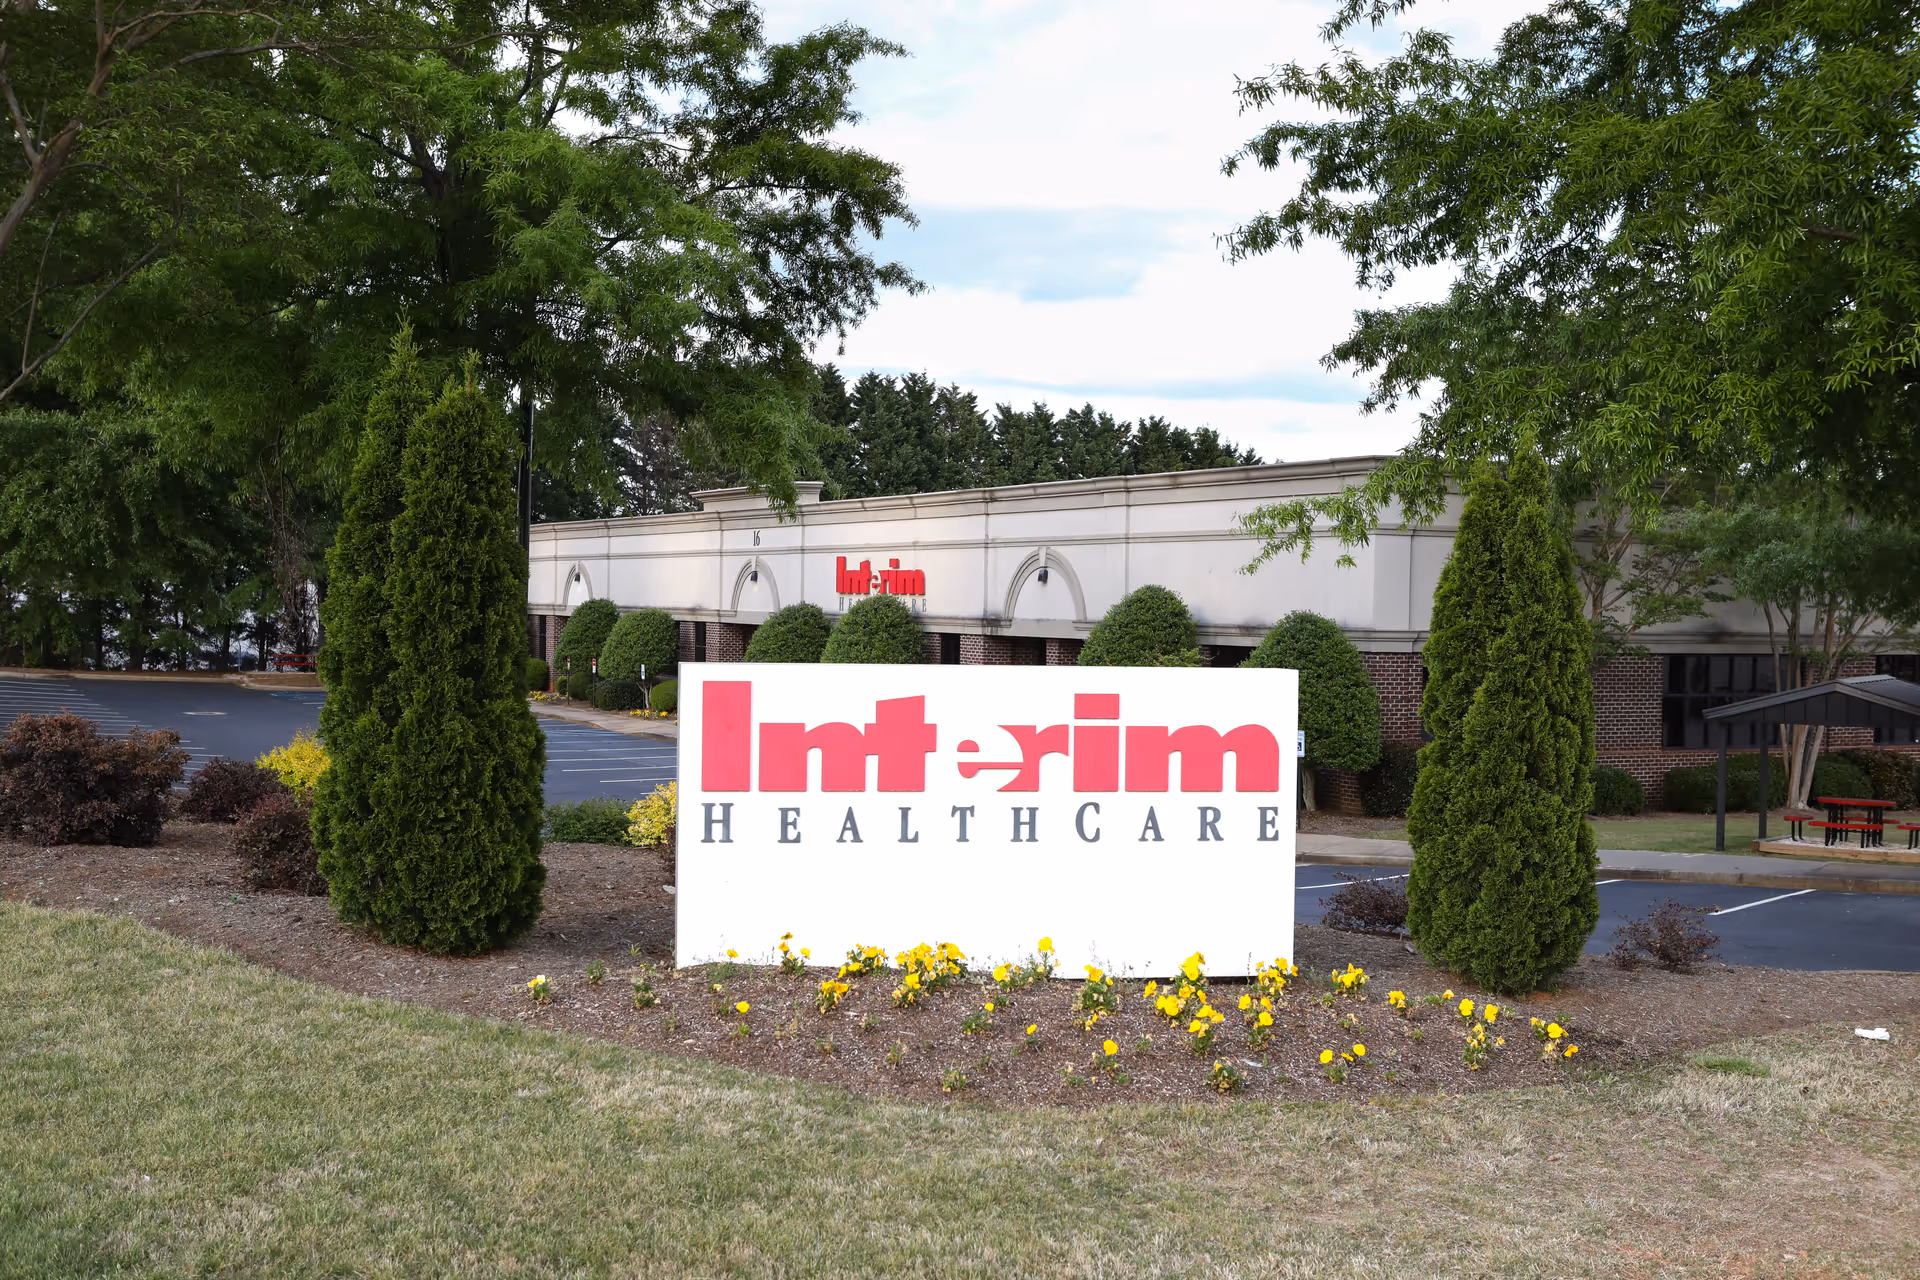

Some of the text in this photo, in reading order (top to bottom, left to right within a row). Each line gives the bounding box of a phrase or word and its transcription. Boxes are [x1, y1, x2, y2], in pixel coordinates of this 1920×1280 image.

[752, 530, 761, 547] 16
[836, 556, 925, 595] Interim
[702, 681, 1279, 792] Interim
[701, 802, 1279, 844] HEALTHCARE
